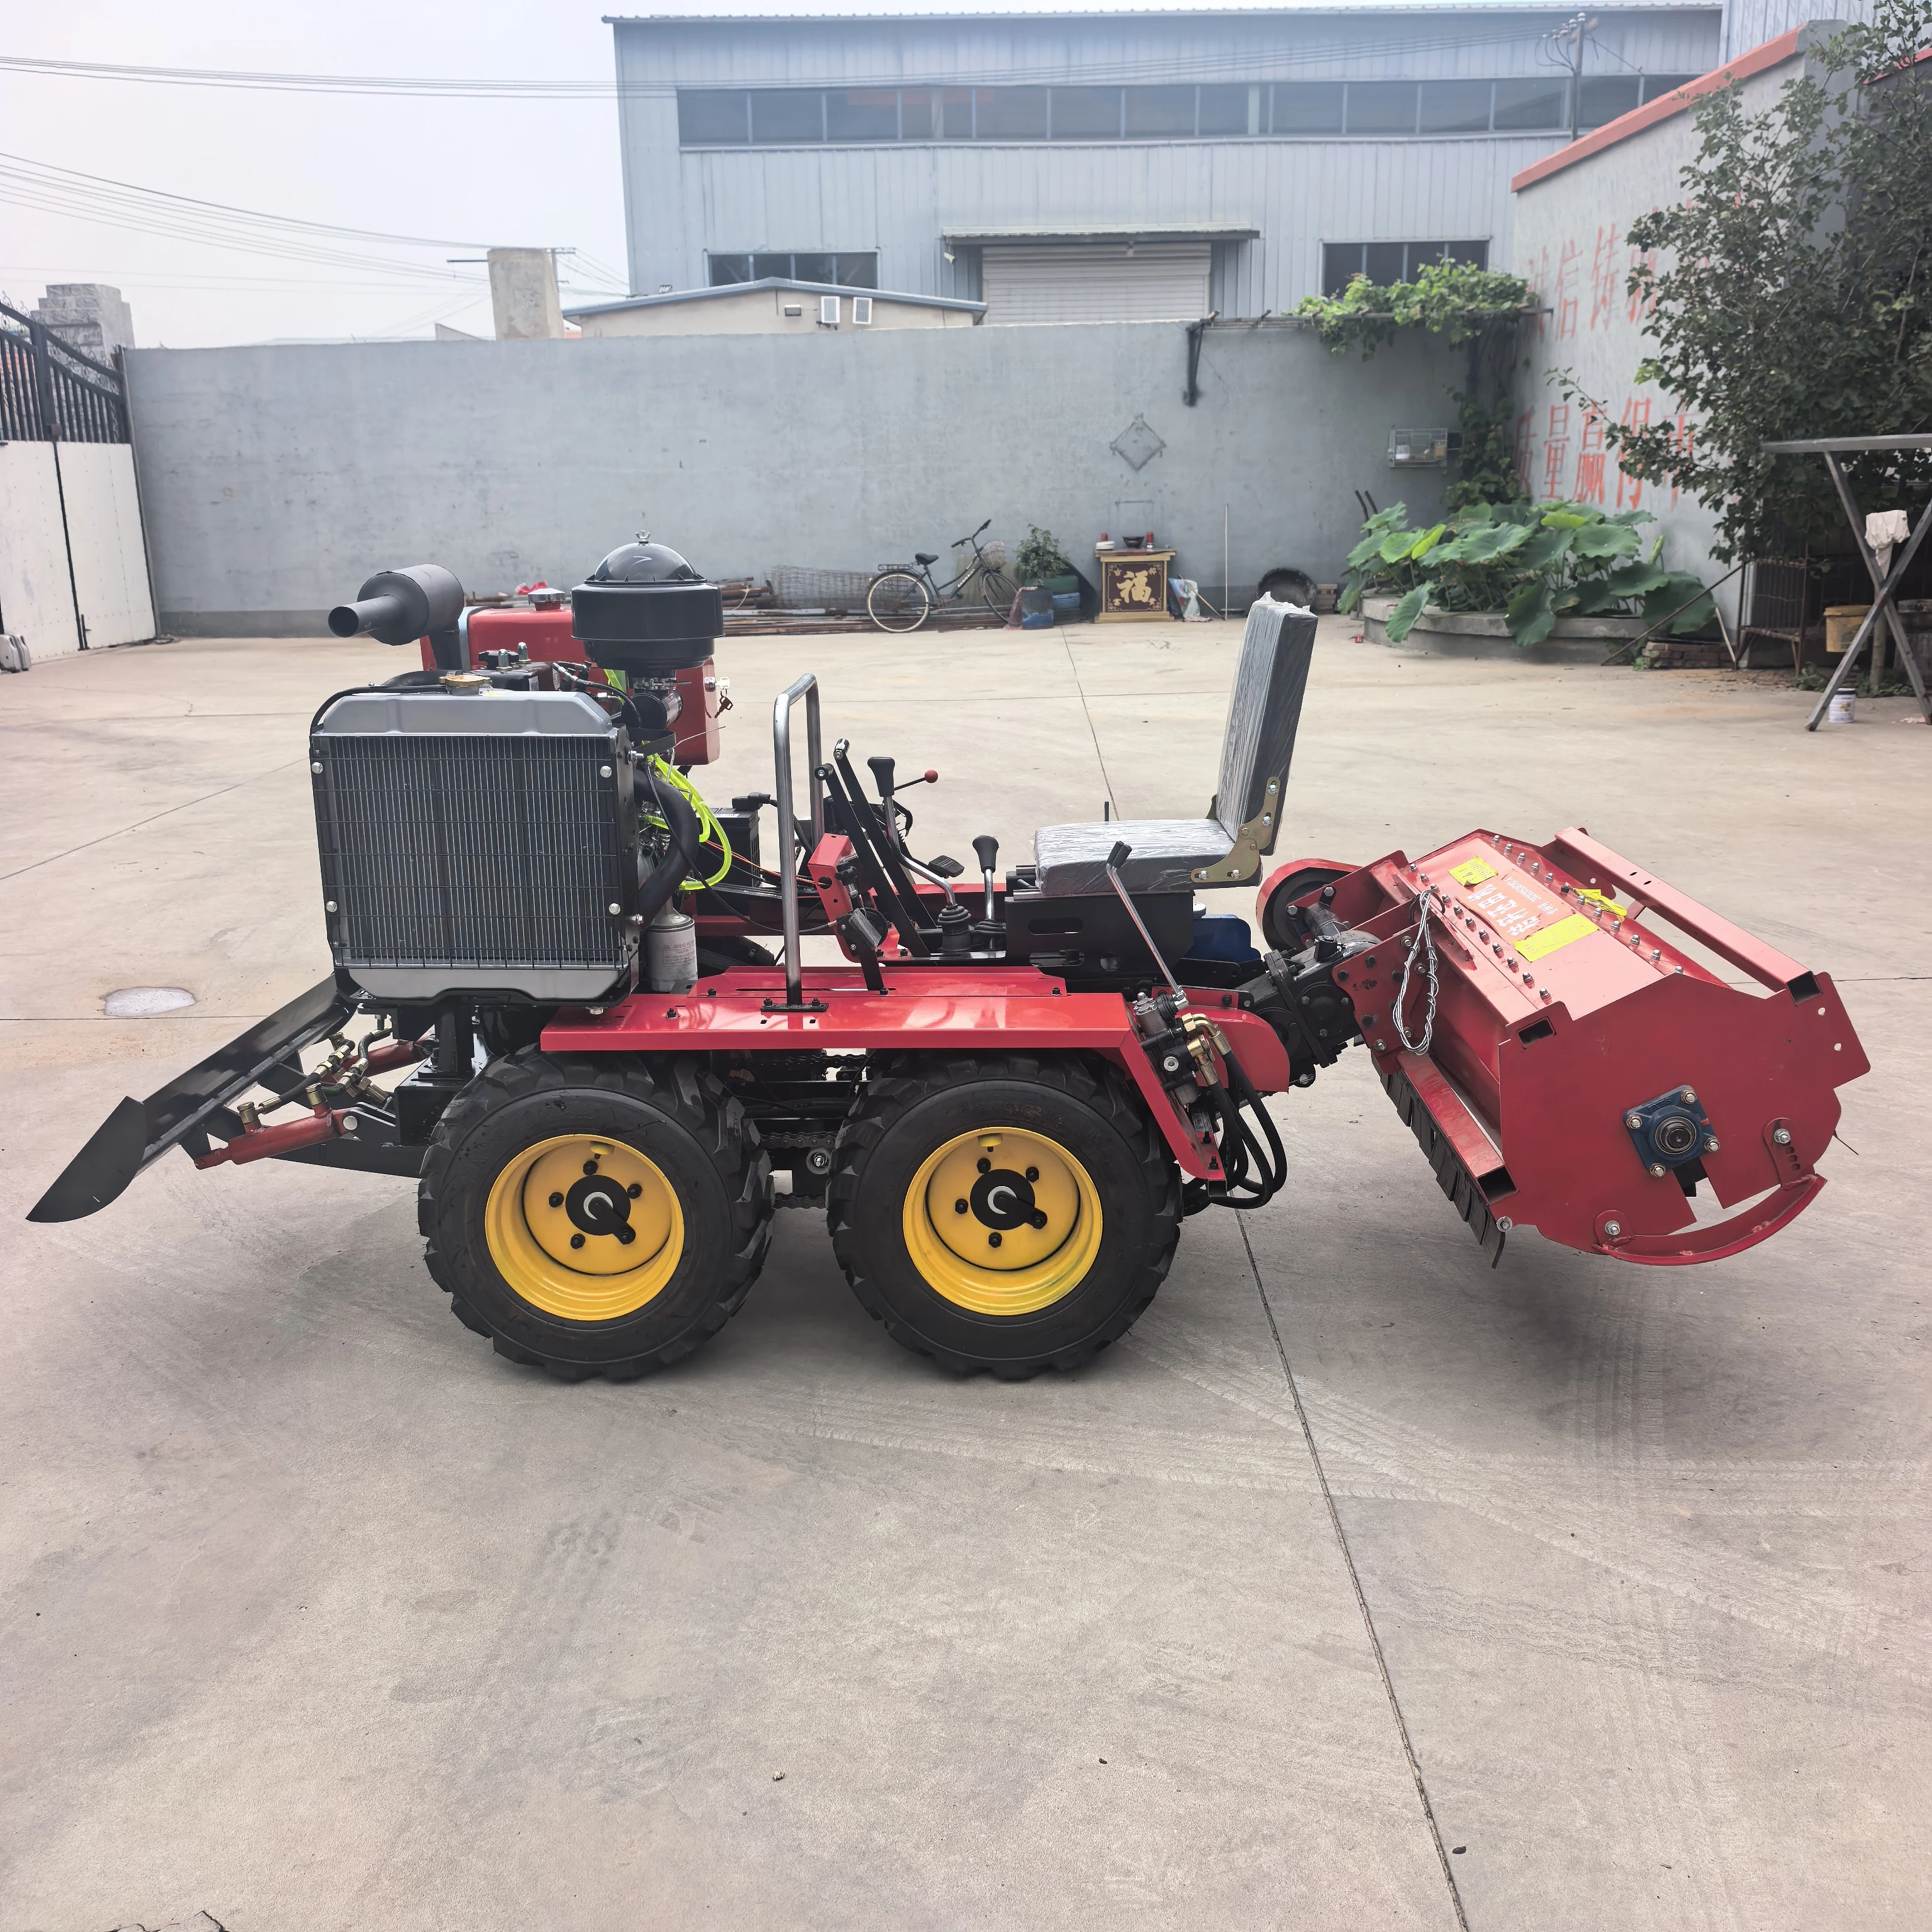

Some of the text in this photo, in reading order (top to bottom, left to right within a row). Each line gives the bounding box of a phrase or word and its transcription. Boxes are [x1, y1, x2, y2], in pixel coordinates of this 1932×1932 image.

[1116, 570, 1152, 604] 福
[1467, 883, 1541, 936] 秸秆还田机
